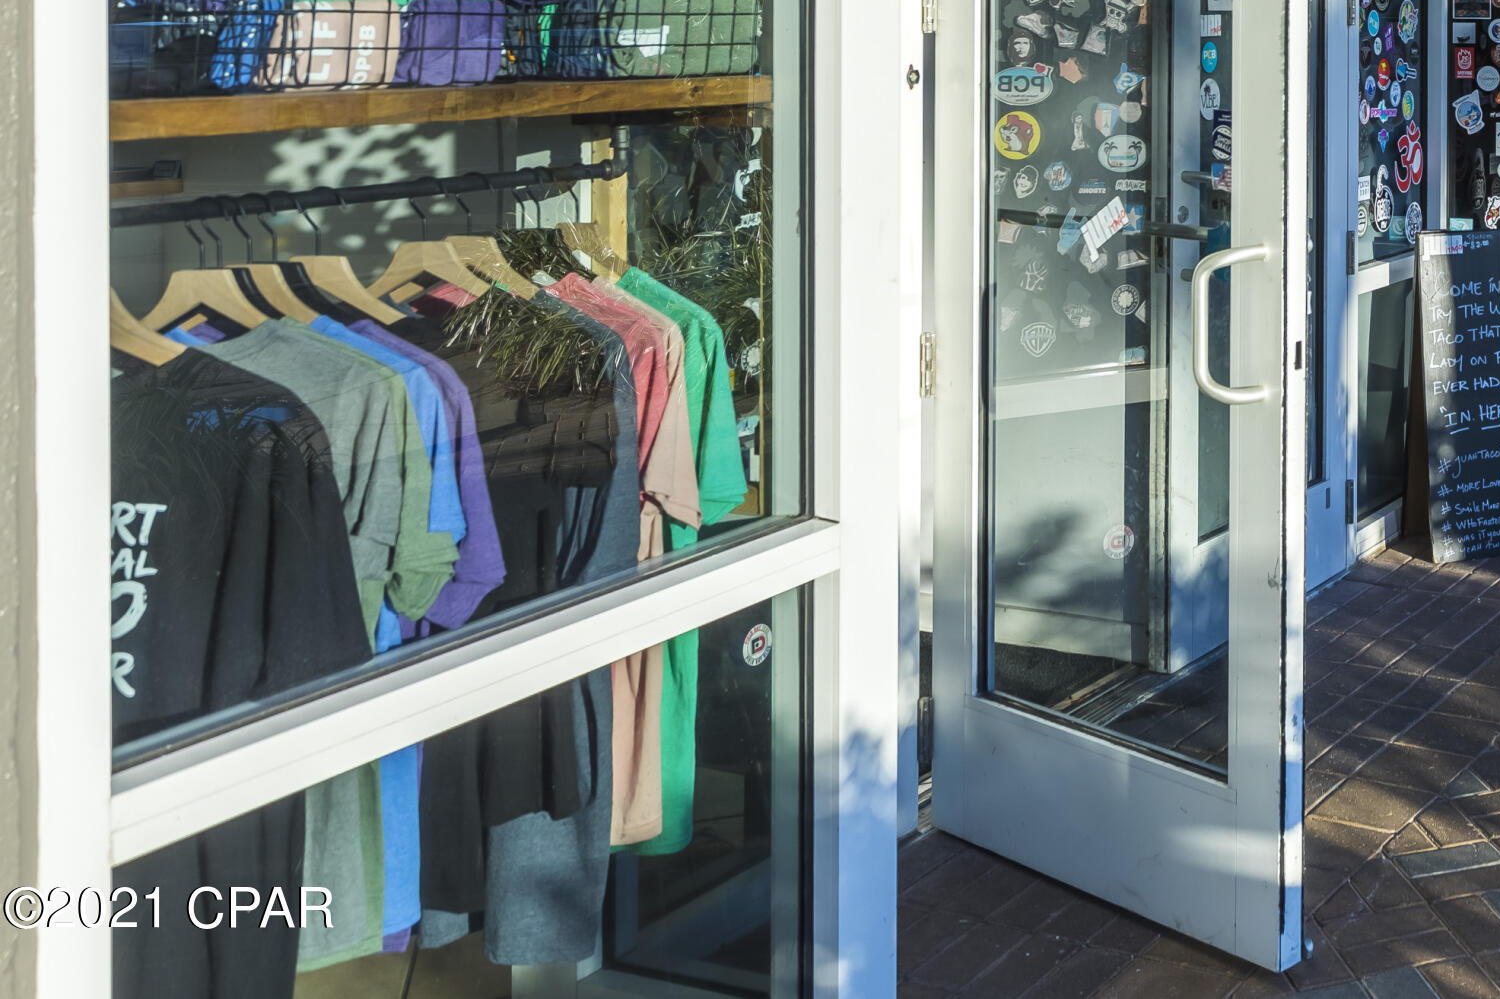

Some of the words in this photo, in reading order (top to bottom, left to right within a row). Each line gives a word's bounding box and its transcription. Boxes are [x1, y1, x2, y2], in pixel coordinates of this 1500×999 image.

[1457, 303, 1485, 319] THE
[1429, 328, 1464, 345] TACO
[1433, 380, 1470, 396] EVER
[111, 547, 159, 581] AL
